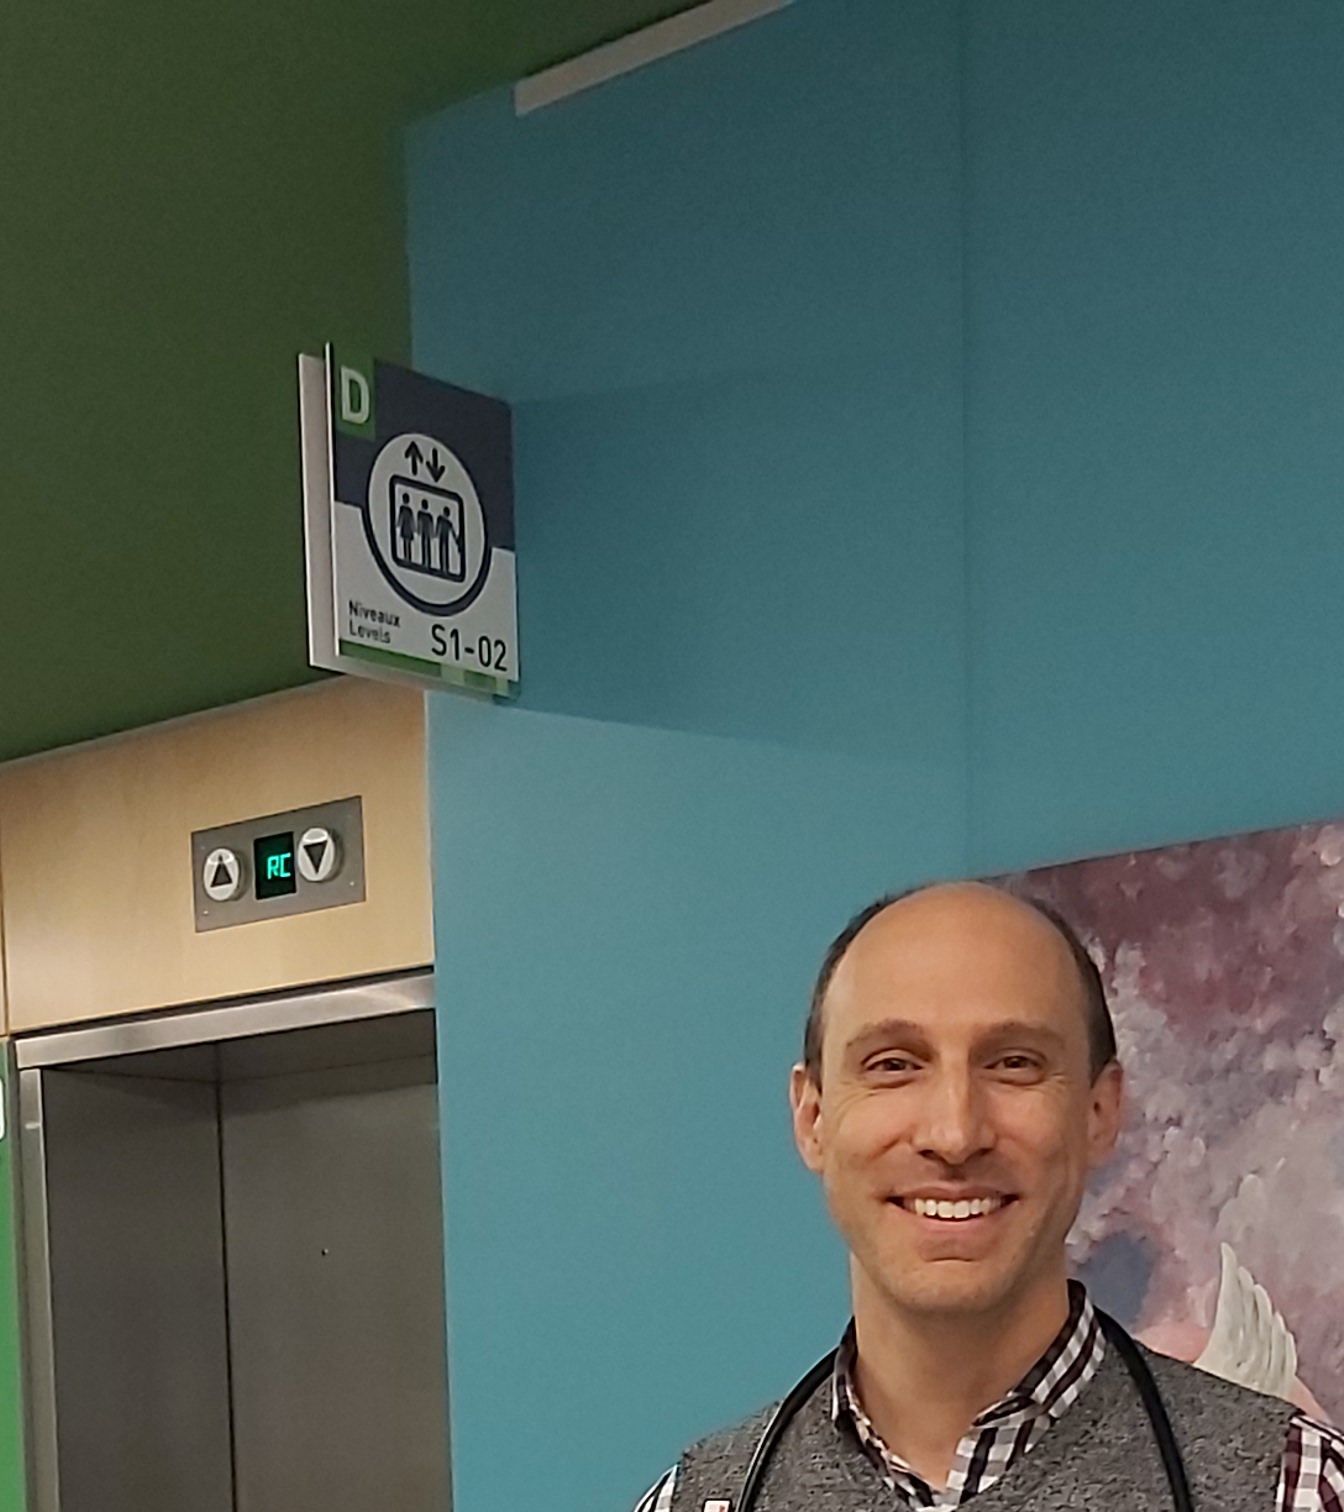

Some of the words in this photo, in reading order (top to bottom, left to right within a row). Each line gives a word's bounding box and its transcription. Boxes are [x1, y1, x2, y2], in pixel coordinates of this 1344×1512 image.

[340, 366, 371, 425] D
[348, 600, 401, 628] Niveaux
[348, 619, 392, 644] Levels
[431, 623, 509, 672] S1-02
[266, 852, 292, 880] RC
